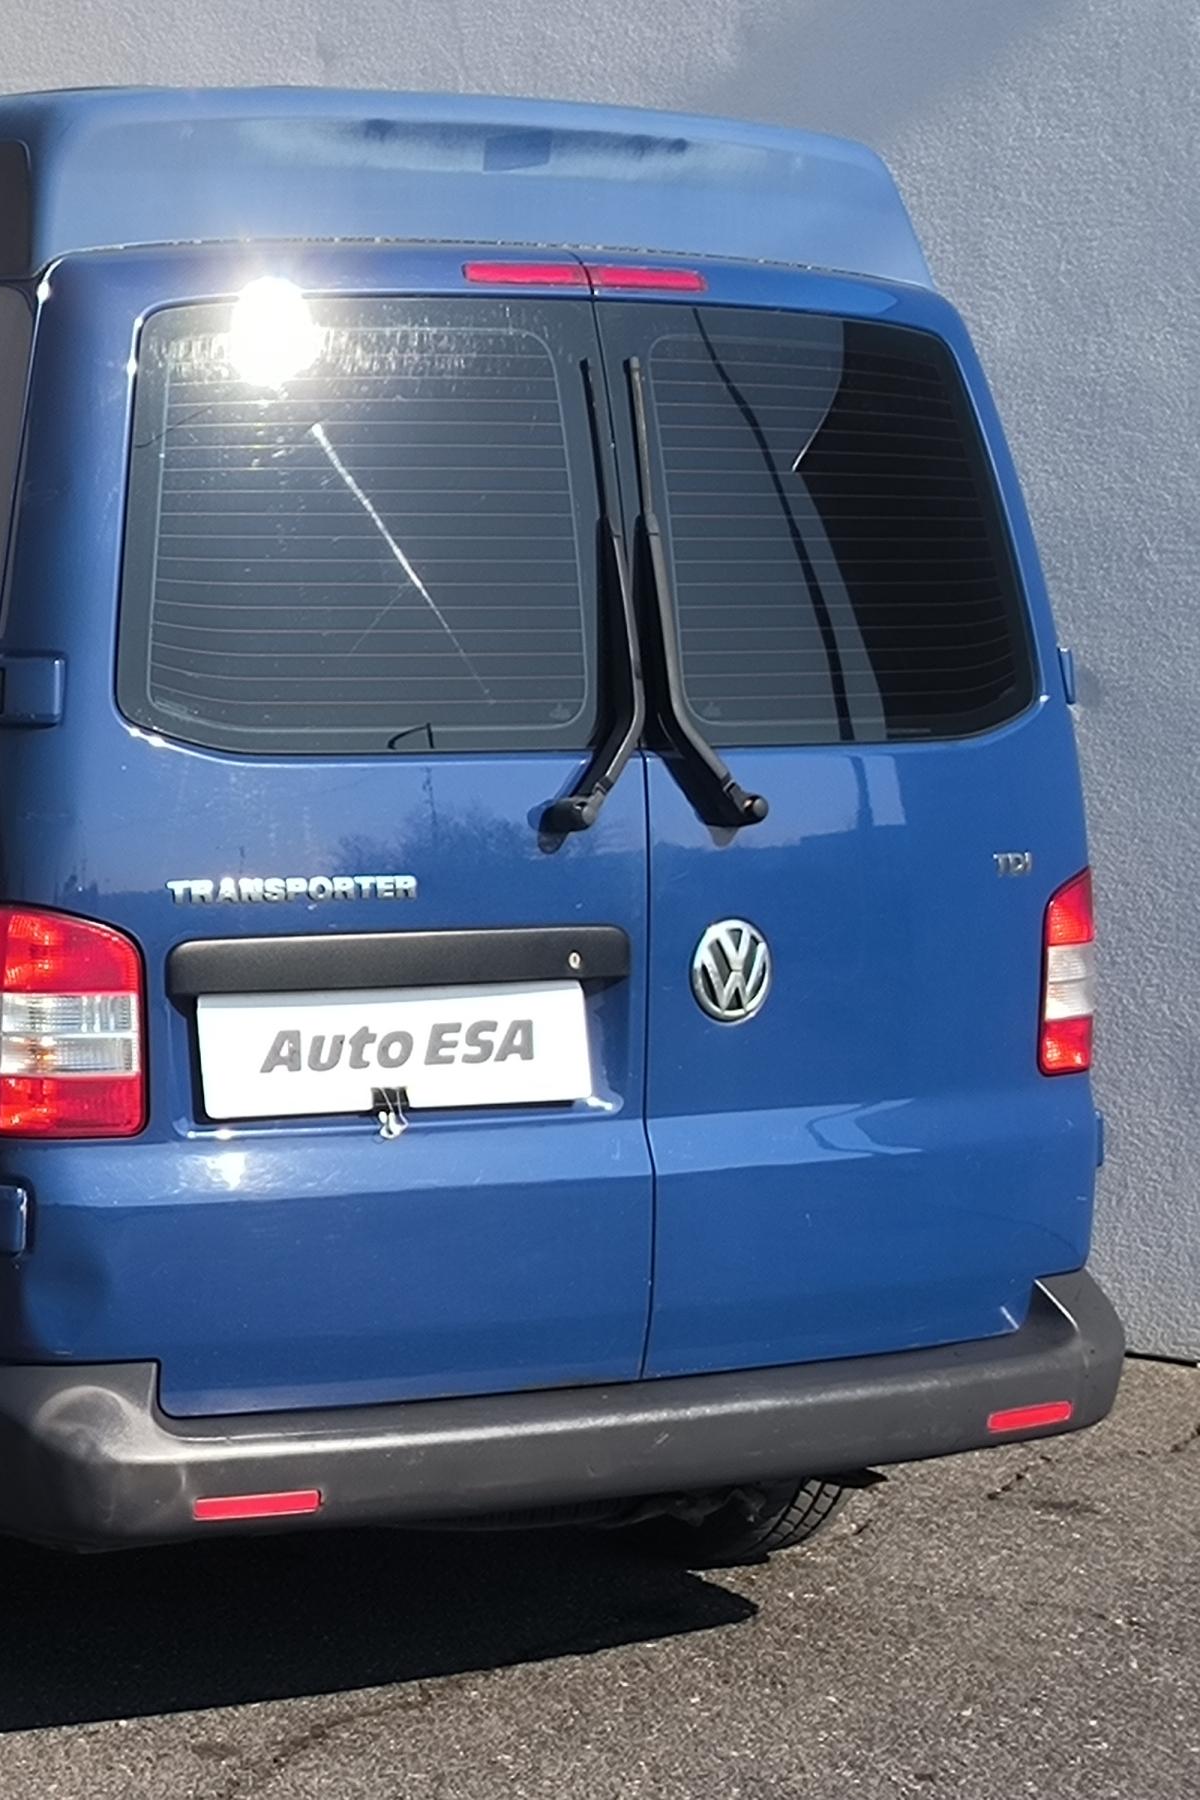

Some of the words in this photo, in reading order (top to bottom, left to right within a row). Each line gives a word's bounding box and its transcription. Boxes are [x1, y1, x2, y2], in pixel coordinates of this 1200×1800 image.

[993, 852, 1032, 876] TDI
[166, 875, 417, 902] TRANSPORTER
[693, 919, 771, 1020] VW
[260, 1025, 413, 1072] Auto
[423, 1019, 535, 1066] ESA
